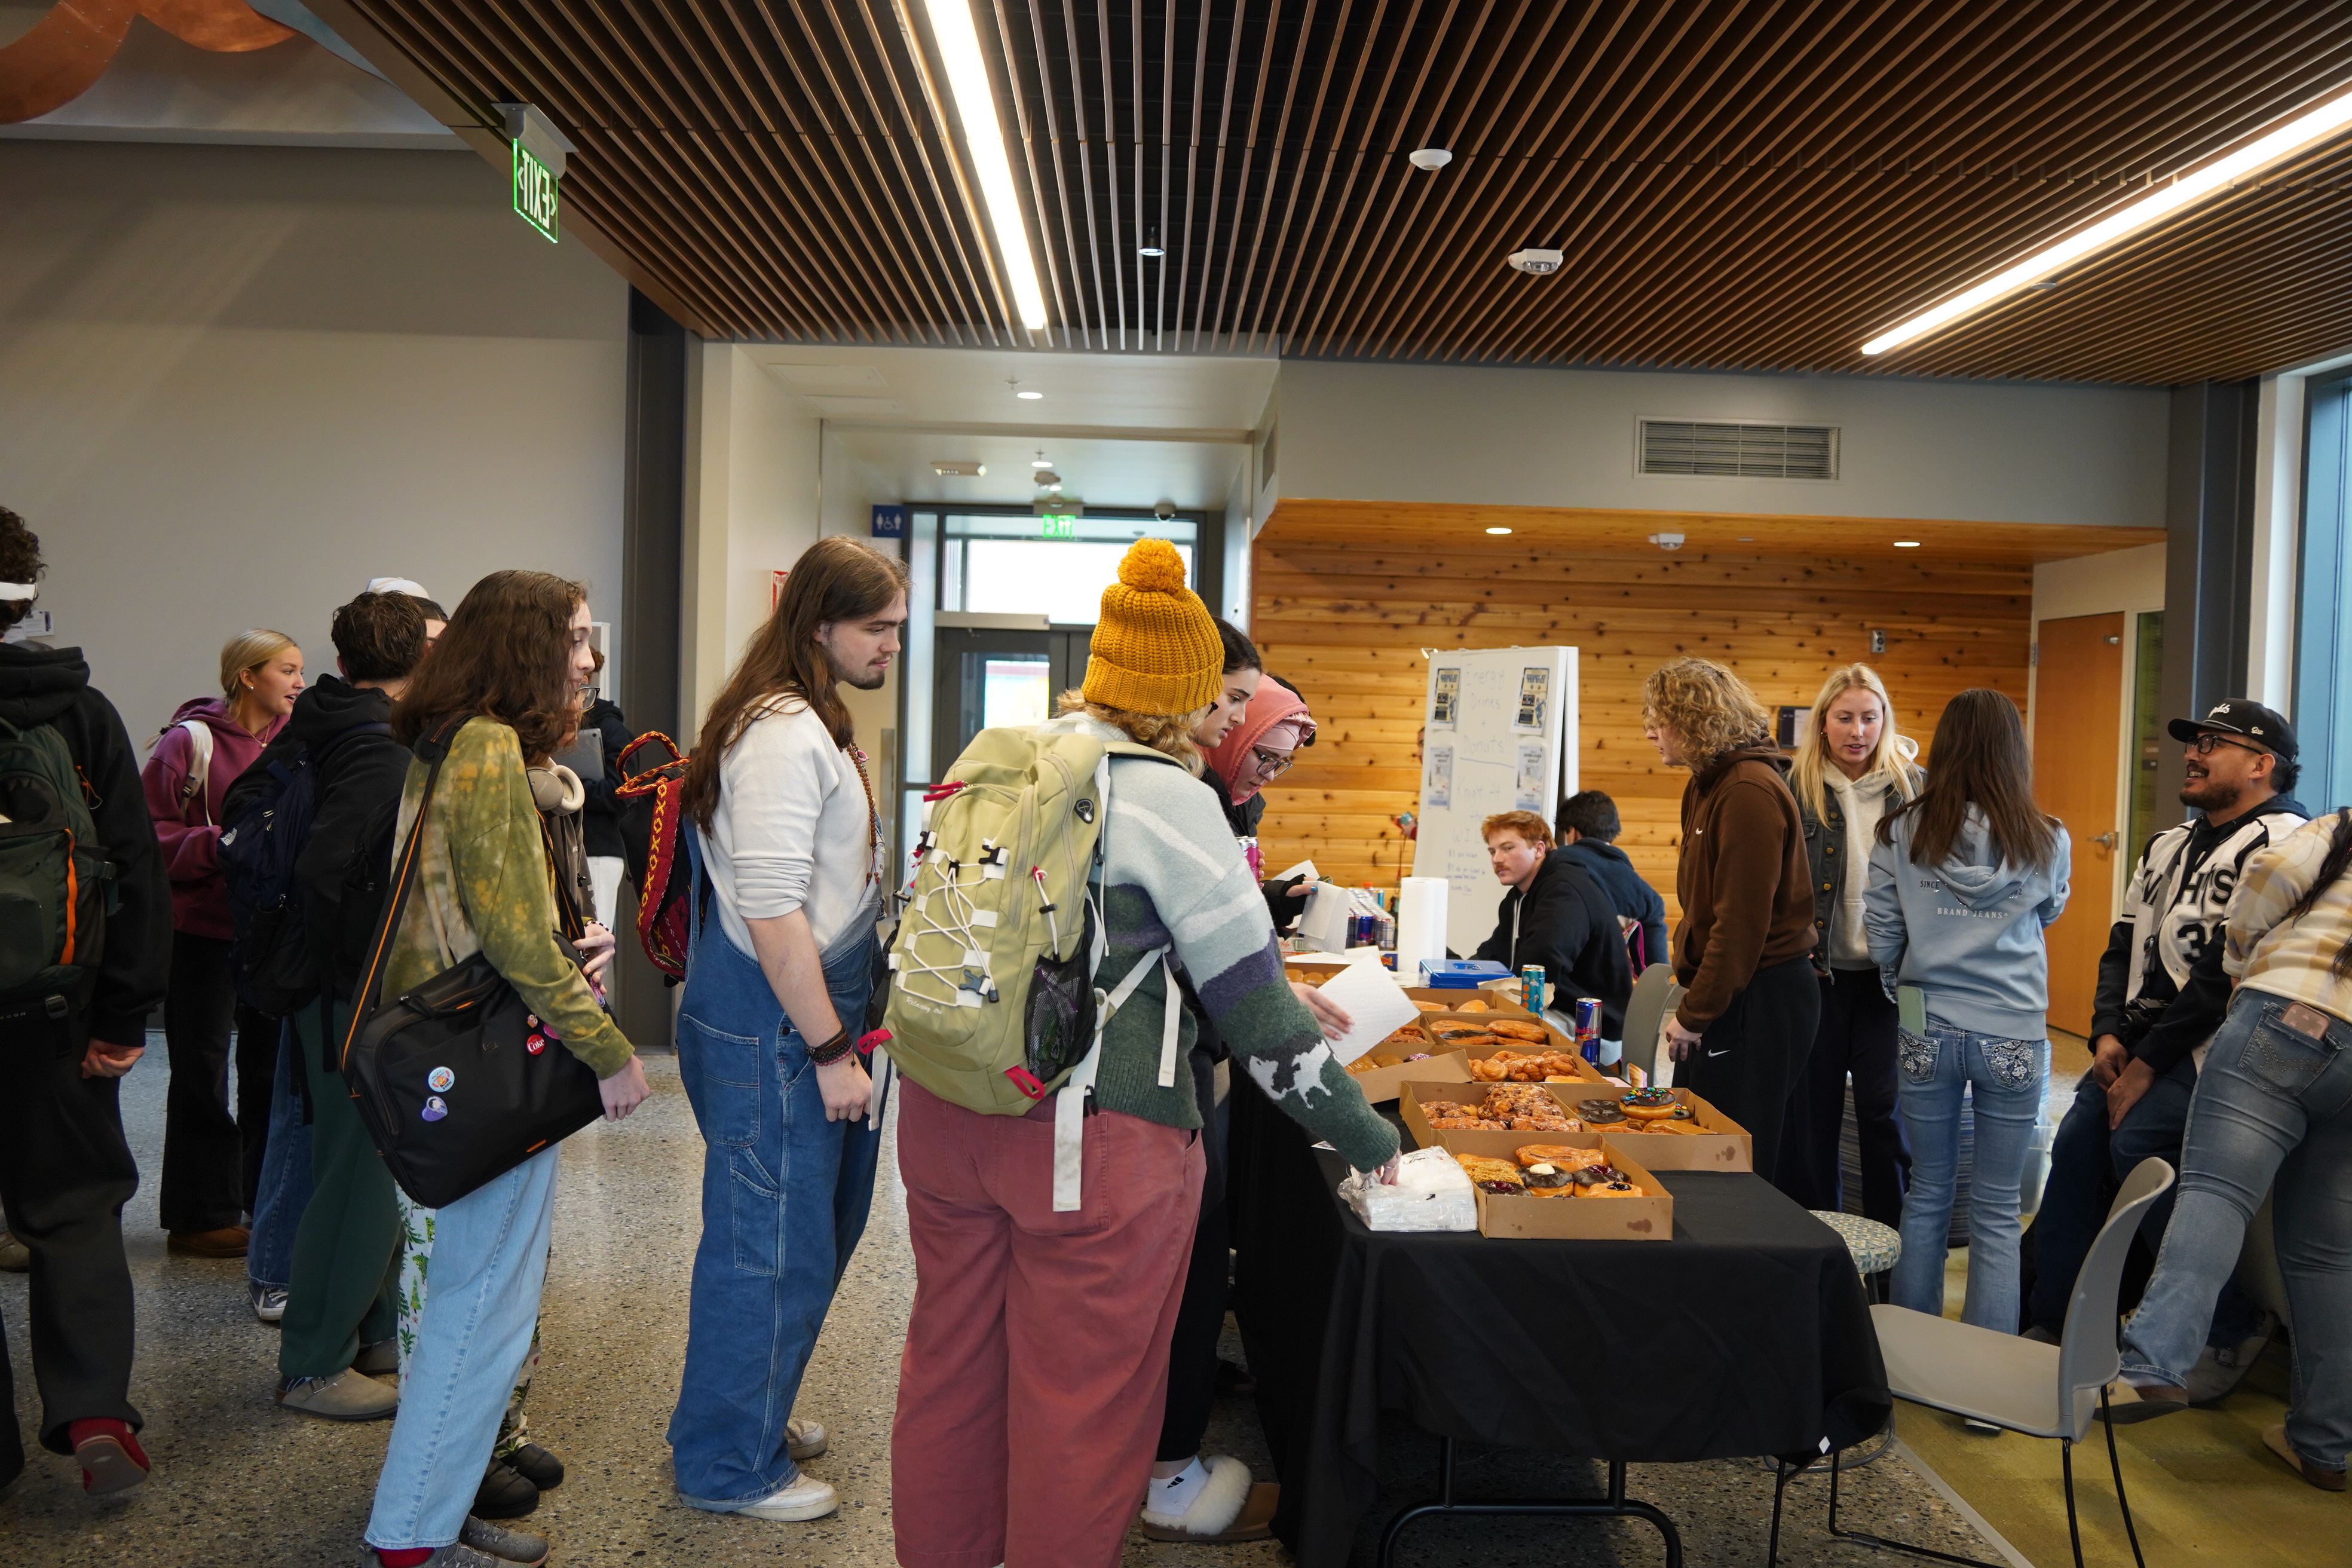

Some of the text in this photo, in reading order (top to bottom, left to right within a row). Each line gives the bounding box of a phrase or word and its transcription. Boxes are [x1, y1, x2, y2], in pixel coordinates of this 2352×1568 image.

[1043, 514, 1075, 537] EXIT
[1466, 663, 1505, 690] Energy
[1471, 692, 1501, 710] Drinks
[1920, 880, 1940, 889] SINCE
[1937, 907, 1968, 917] BRAND
[528, 1039, 545, 1052] Coke
